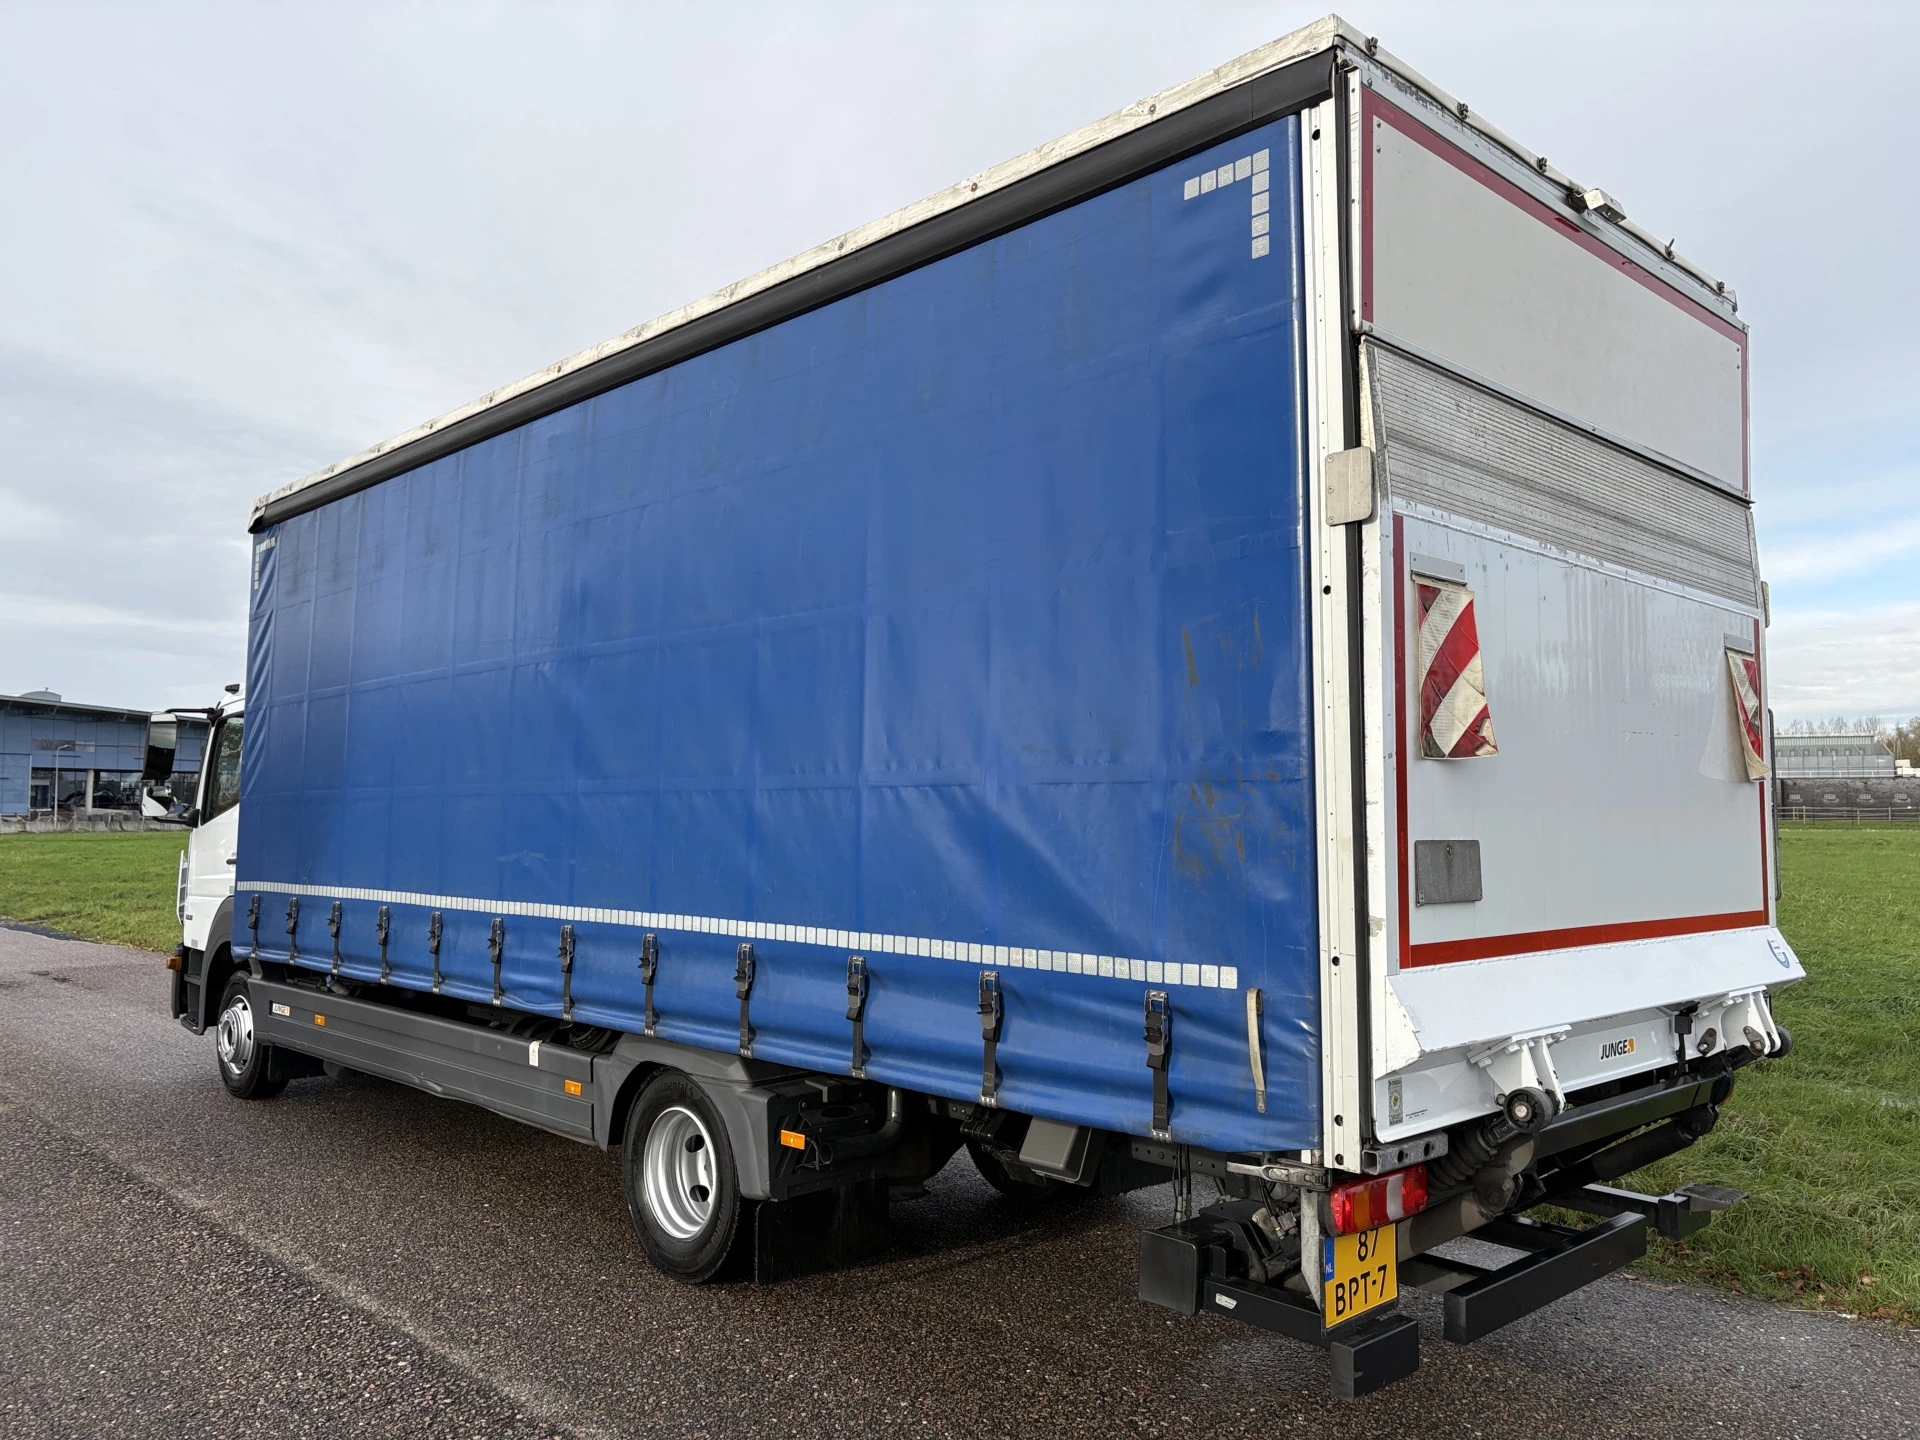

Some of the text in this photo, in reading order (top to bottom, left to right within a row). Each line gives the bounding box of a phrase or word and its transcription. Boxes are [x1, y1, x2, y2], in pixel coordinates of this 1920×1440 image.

[1600, 1039, 1628, 1060] JUNGE
[1357, 1228, 1380, 1262] 87
[1325, 1265, 1334, 1274] NL
[1335, 1264, 1388, 1317] BPT-7
